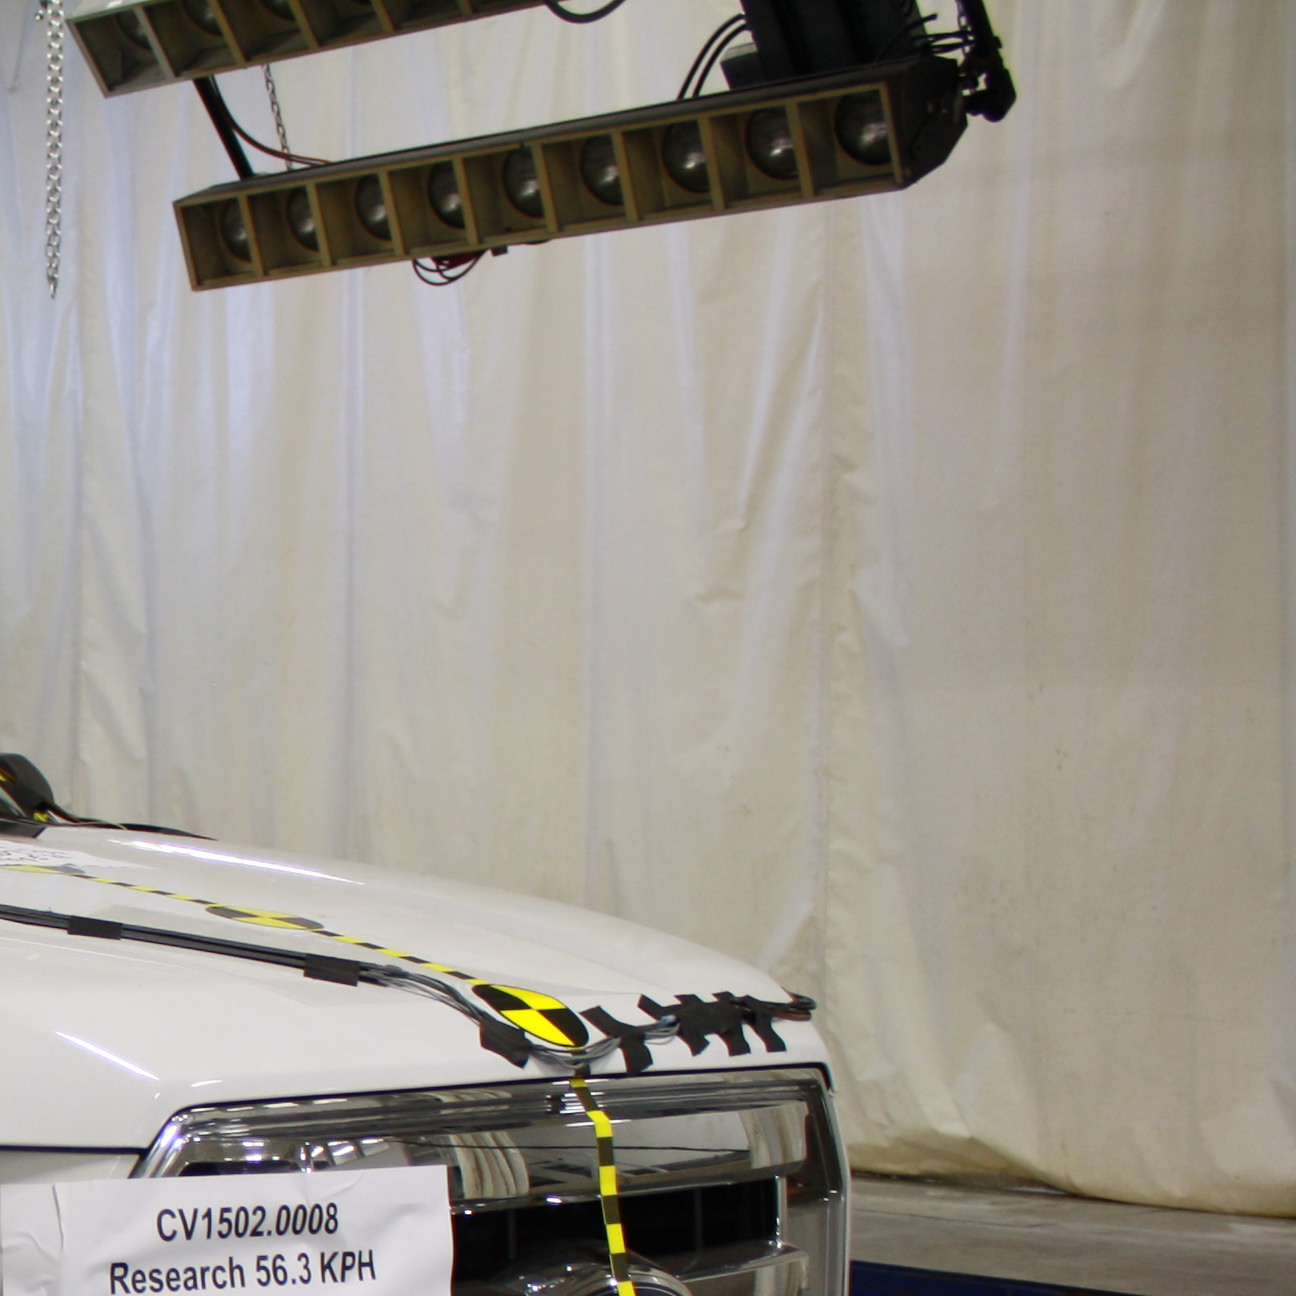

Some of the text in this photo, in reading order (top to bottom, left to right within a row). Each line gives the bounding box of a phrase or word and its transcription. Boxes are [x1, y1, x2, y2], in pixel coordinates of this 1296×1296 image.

[156, 1202, 339, 1242] CV1502.0008
[109, 1249, 377, 1295] Research 56.3 KPH
